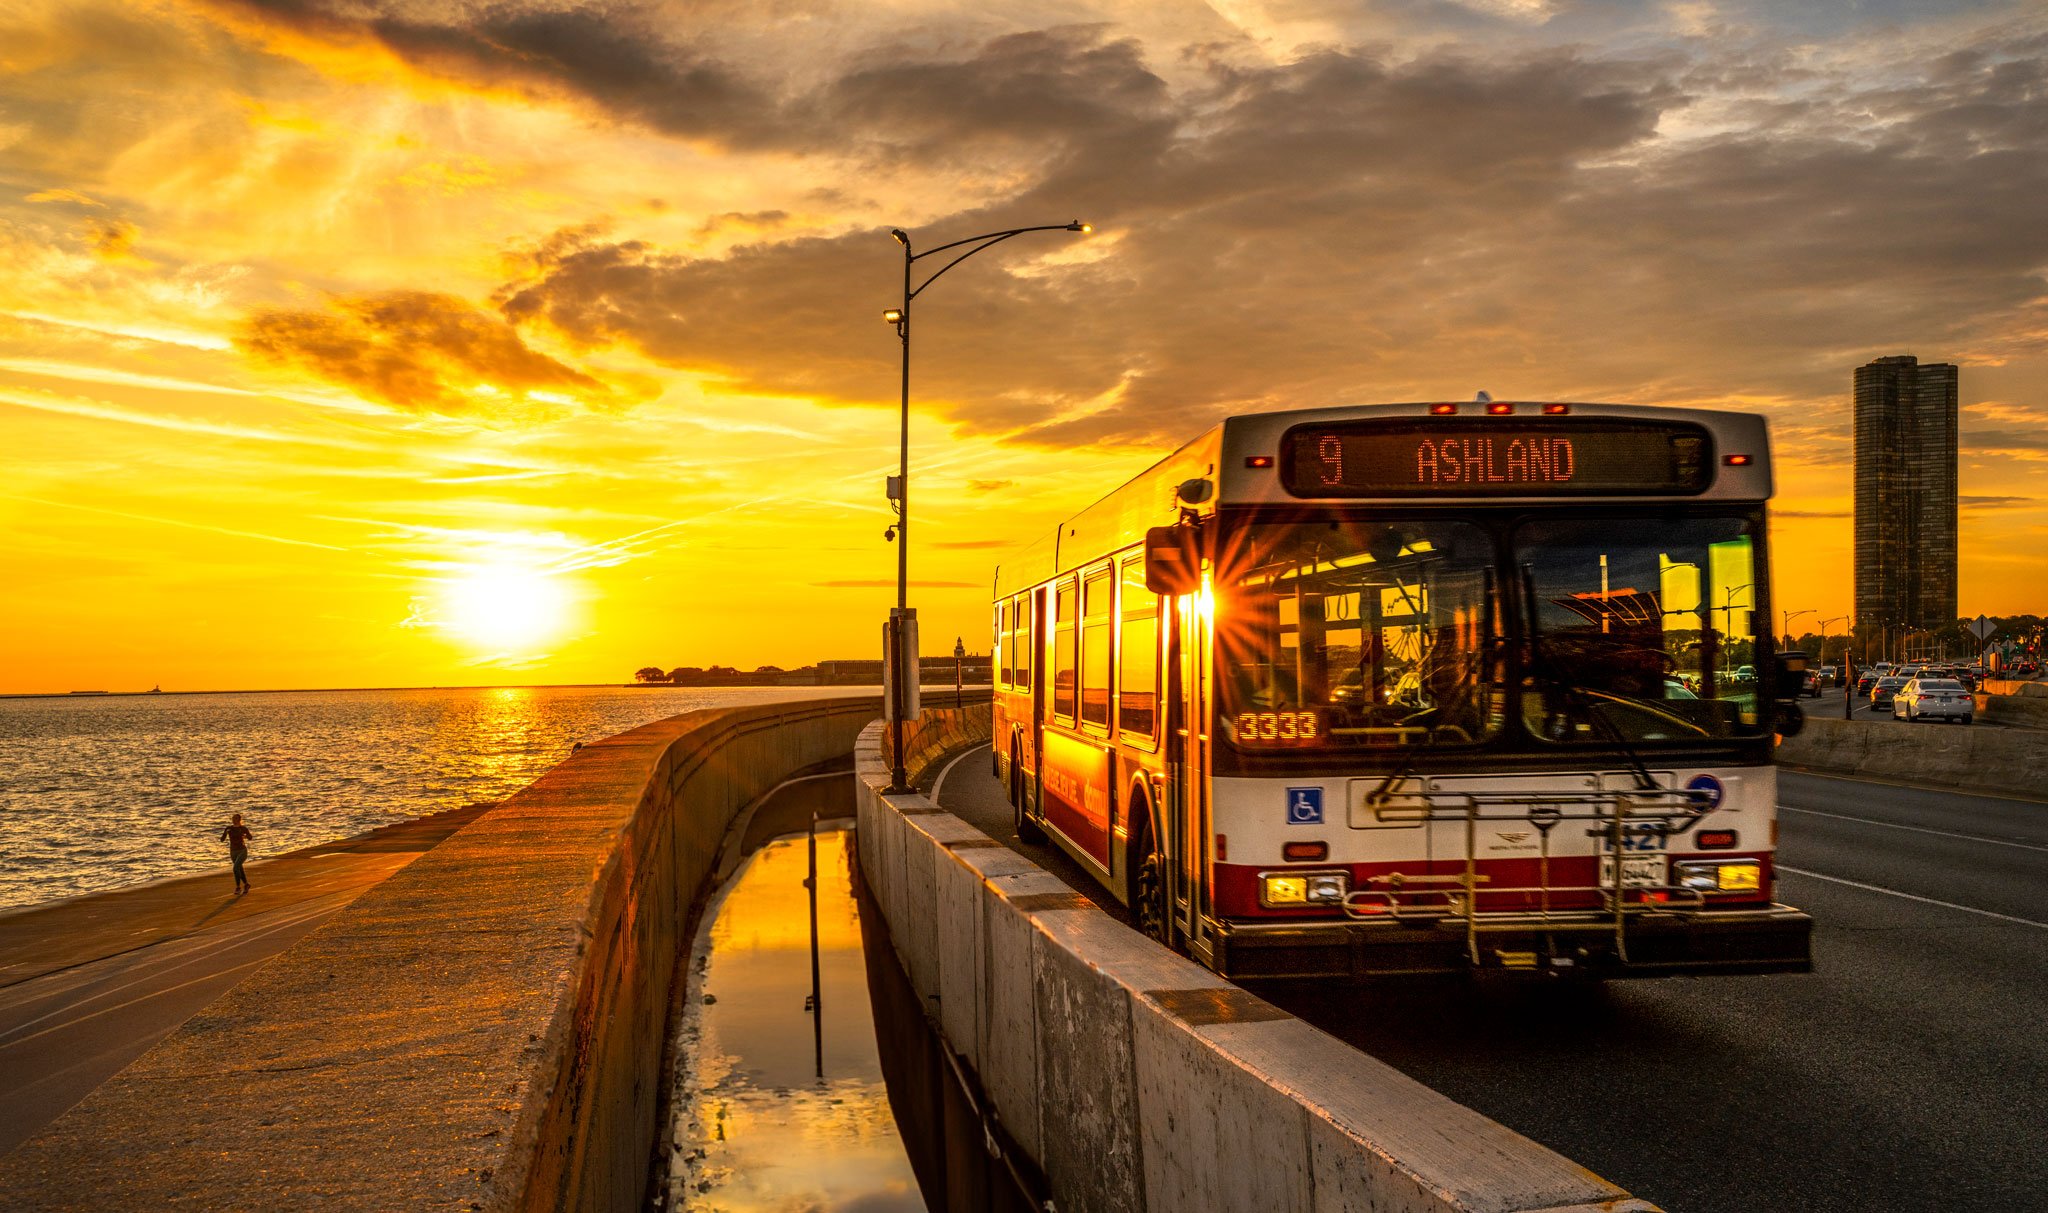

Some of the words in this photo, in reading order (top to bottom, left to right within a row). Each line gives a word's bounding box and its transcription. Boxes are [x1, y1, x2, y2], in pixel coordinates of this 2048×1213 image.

[1320, 435, 1341, 485] 9
[1417, 438, 1573, 482] ASHLAND
[1239, 711, 1316, 739] 3333
